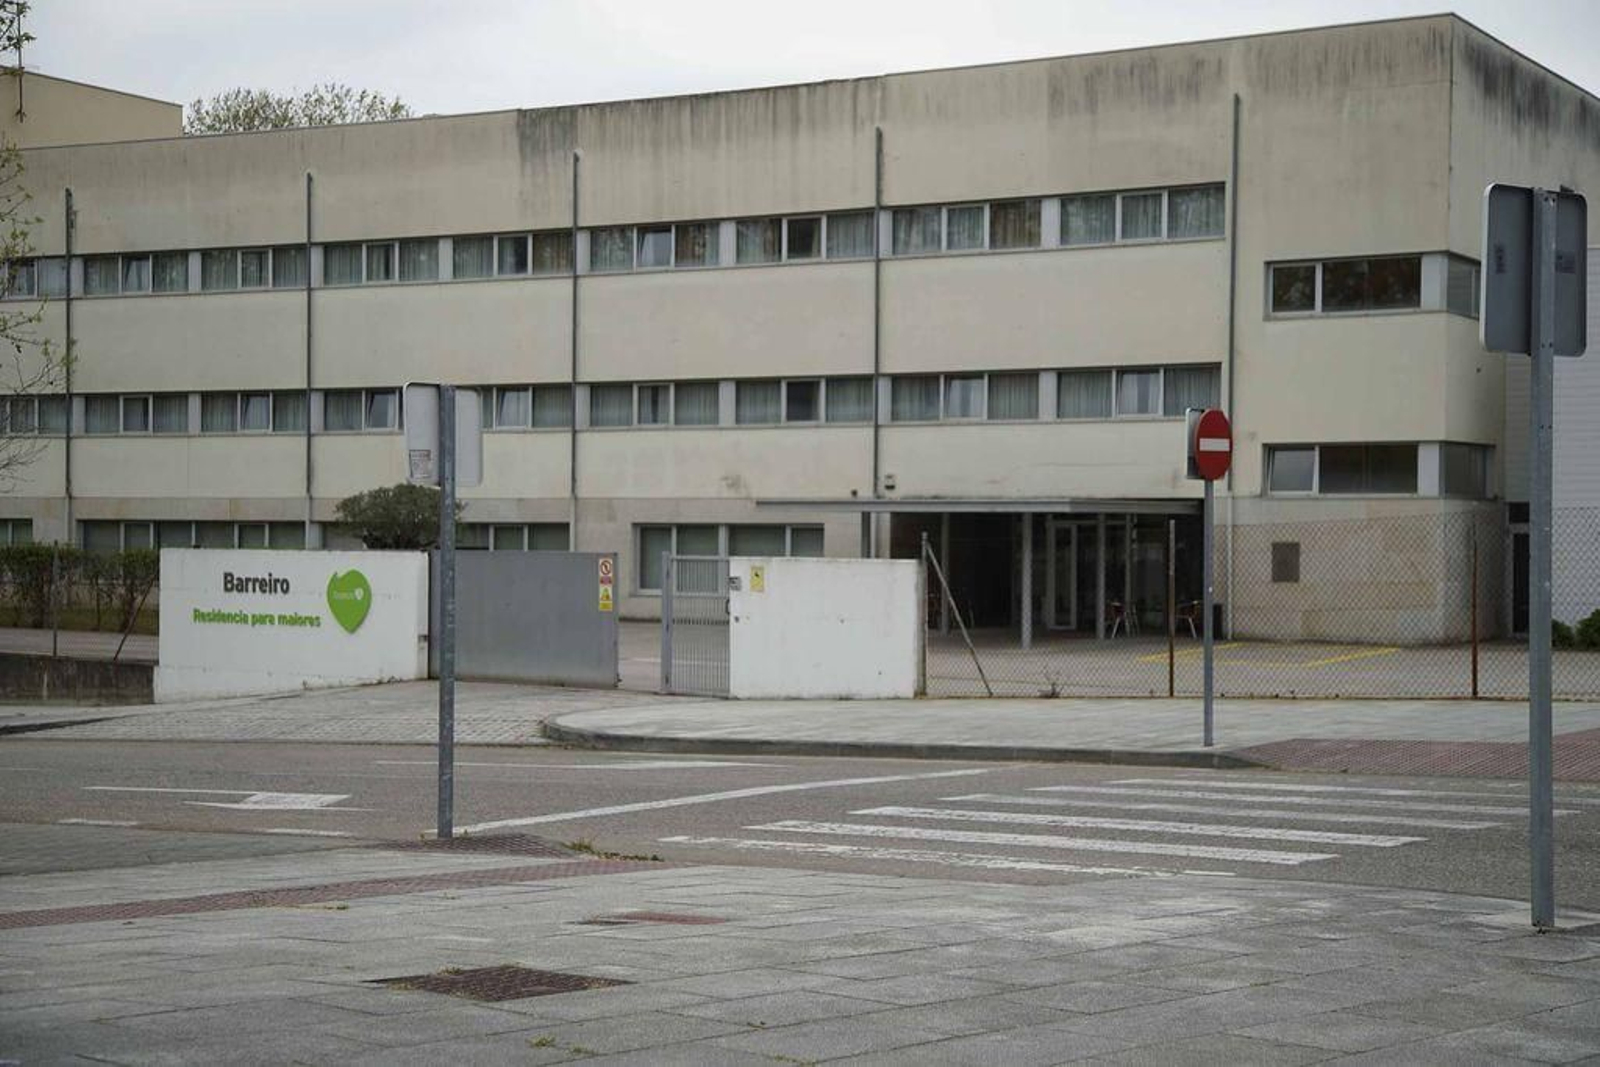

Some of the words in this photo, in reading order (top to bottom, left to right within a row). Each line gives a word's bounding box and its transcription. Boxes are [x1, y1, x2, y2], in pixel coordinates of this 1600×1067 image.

[223, 572, 290, 594] Barreiro
[193, 608, 248, 625] Residencia
[251, 612, 275, 627] para
[278, 611, 321, 628] maiores
